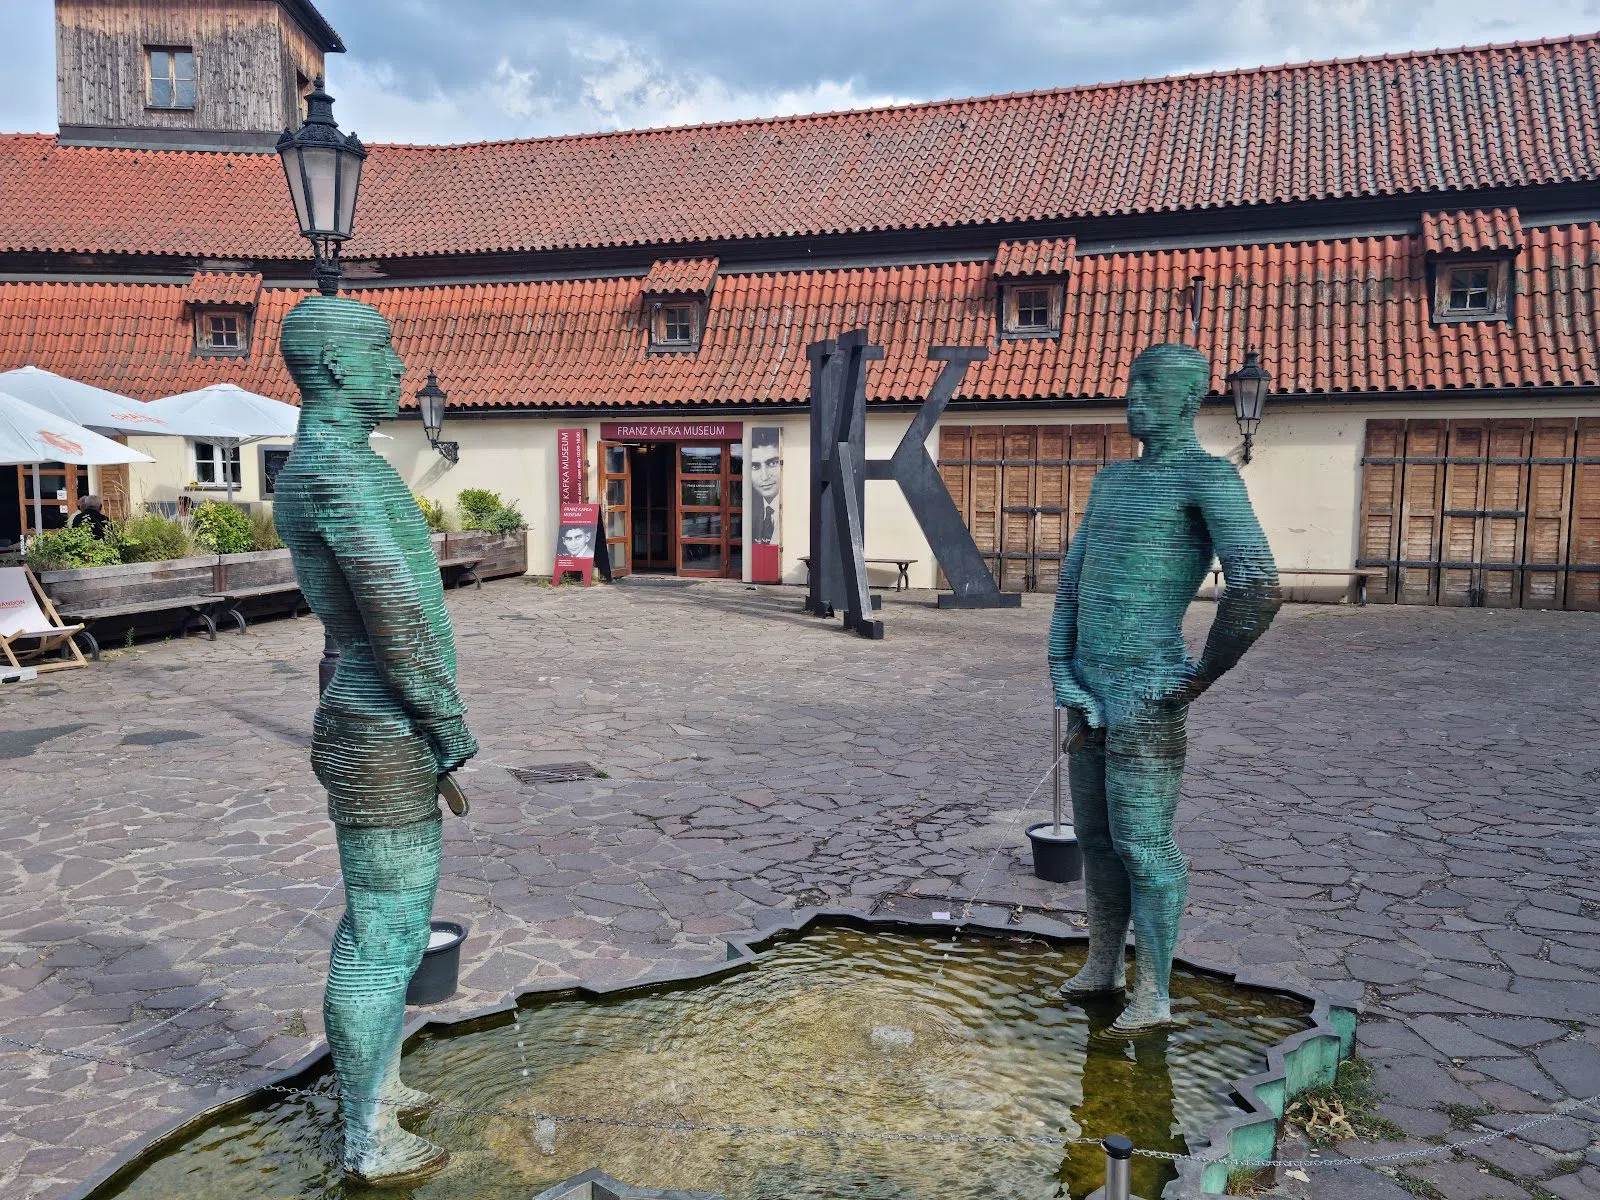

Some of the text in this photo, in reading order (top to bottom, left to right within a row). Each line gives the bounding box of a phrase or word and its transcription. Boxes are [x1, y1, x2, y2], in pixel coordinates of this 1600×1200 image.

[617, 425, 725, 436] FRANZ KAFKA MUSEUM
[561, 432, 569, 470] MUSEUM
[562, 471, 570, 500] KAFKA
